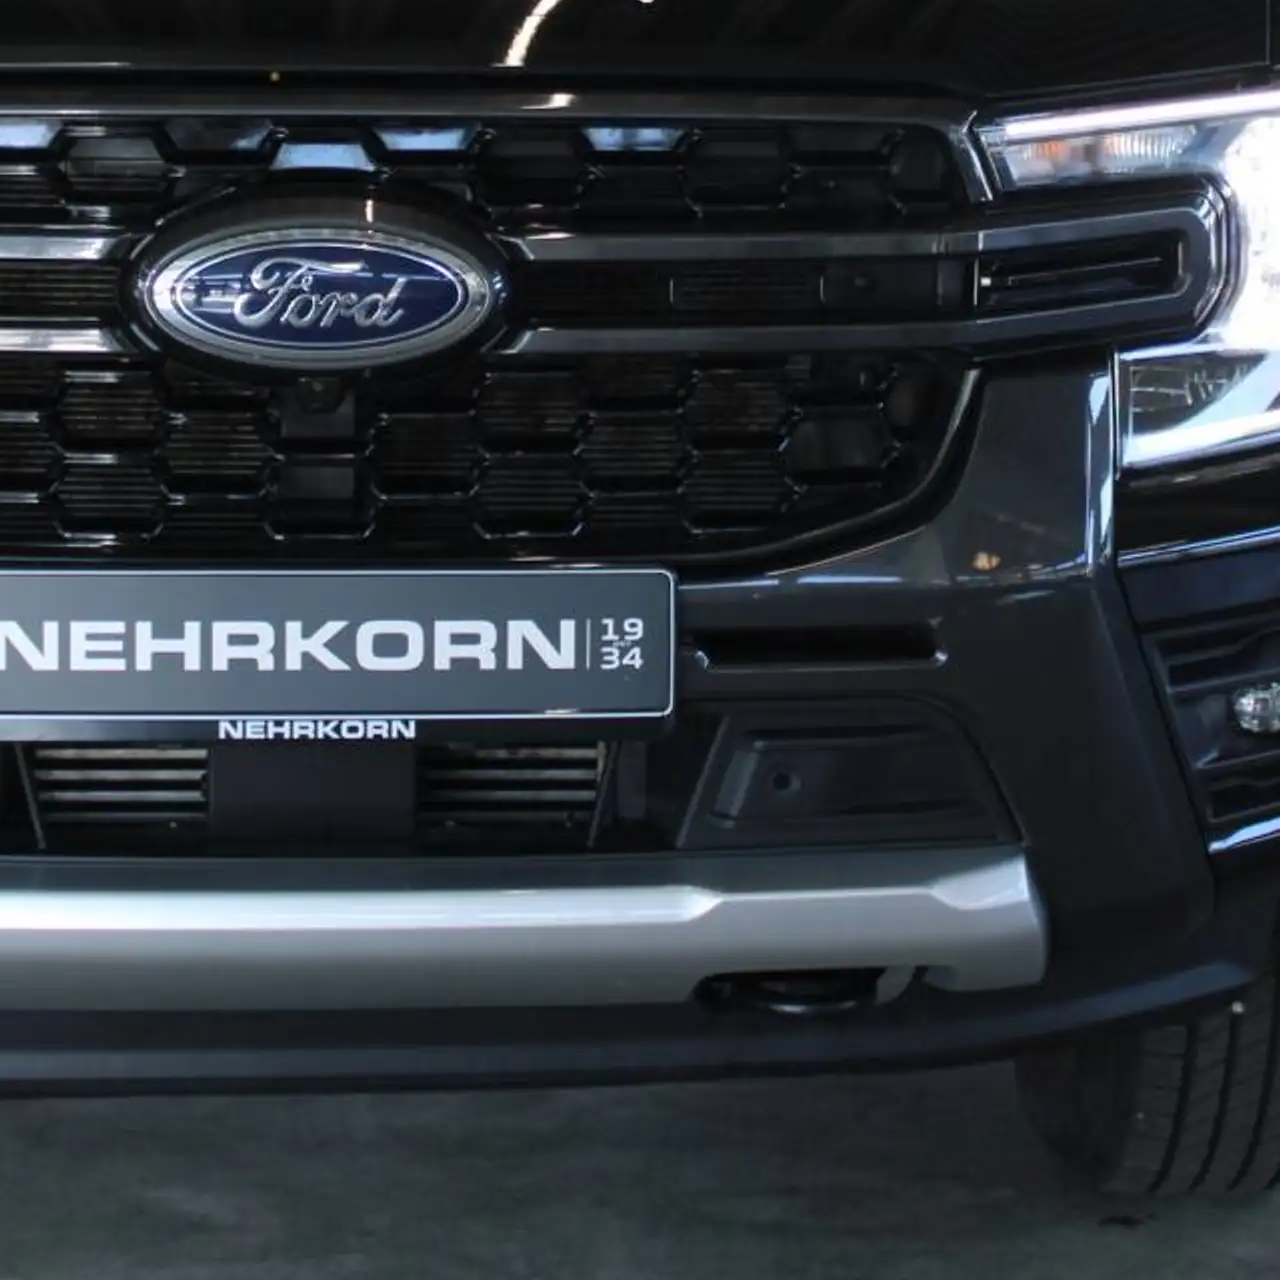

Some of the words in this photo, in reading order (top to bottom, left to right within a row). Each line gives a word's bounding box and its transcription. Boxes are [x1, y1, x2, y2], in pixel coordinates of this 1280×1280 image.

[234, 257, 407, 328] Ford
[601, 618, 643, 640] 19
[600, 647, 644, 669] 34
[218, 720, 416, 740] NEHRKORN
